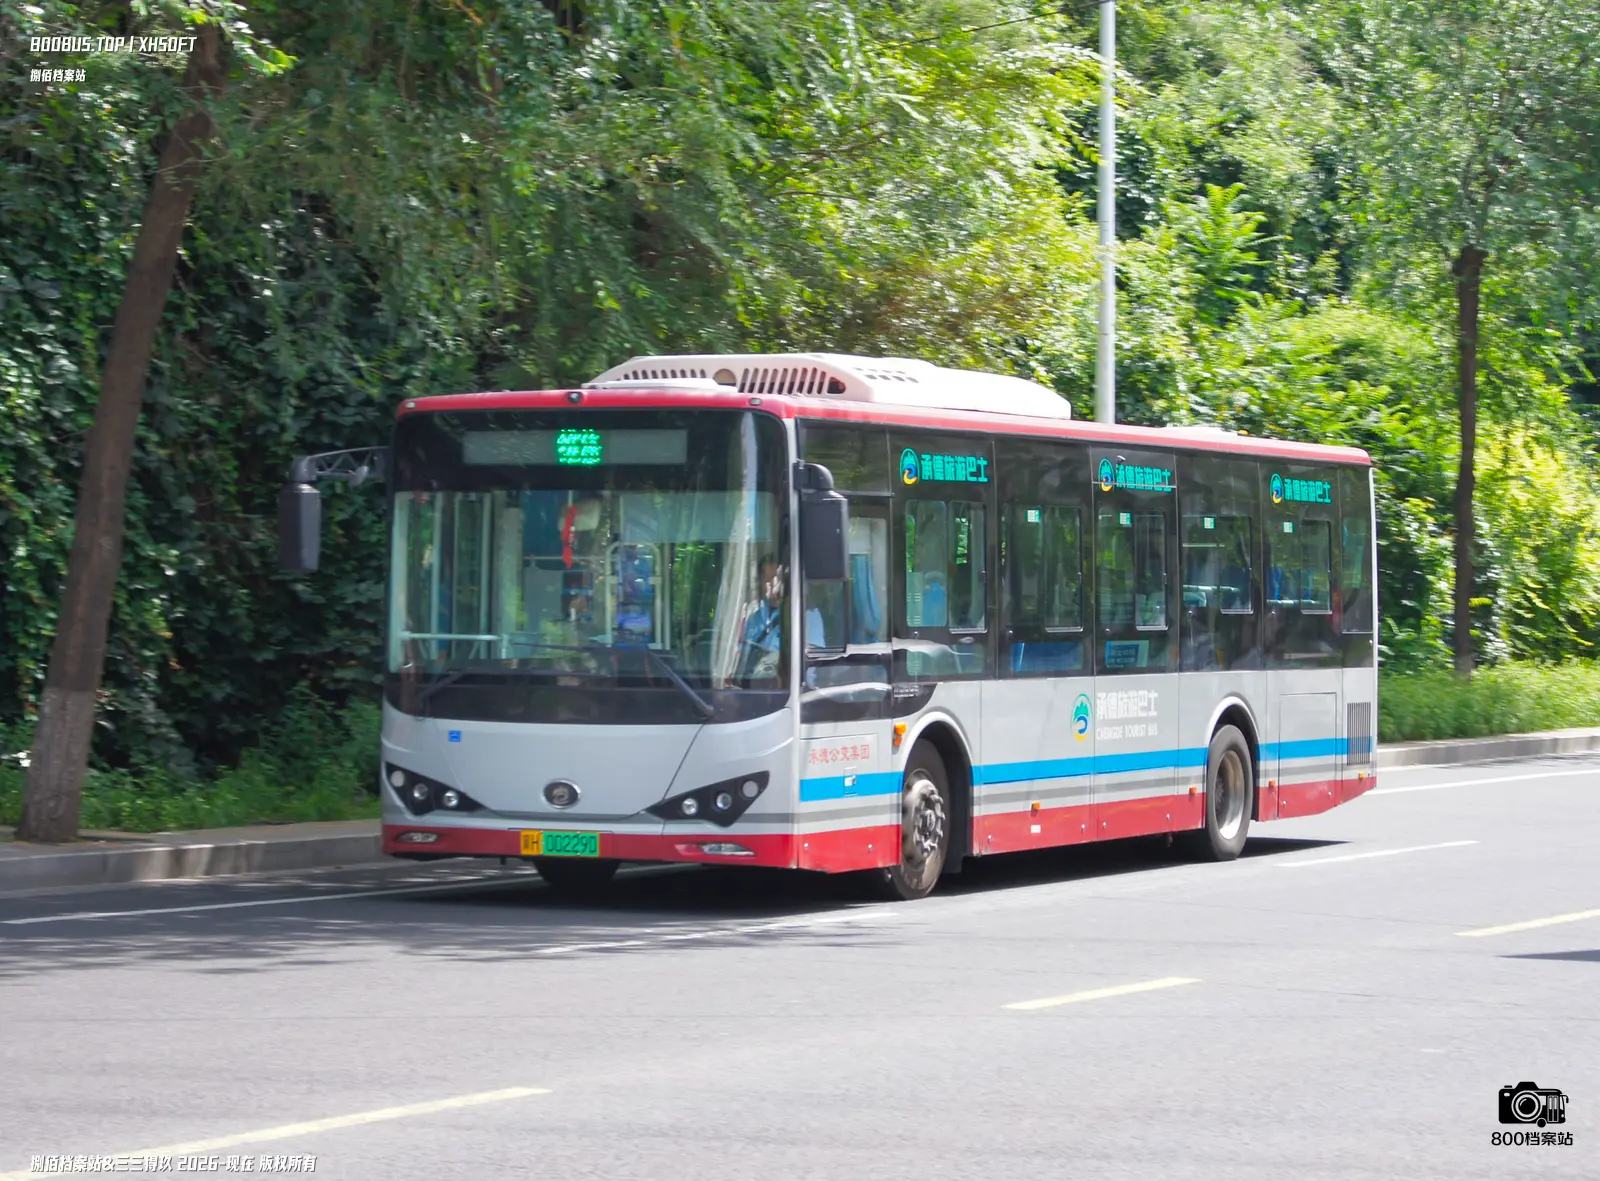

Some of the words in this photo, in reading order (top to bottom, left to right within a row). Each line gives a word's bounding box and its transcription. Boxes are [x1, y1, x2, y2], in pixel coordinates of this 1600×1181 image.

[921, 454, 989, 483] 承德旅游巴士
[1096, 689, 1159, 720] 承德旅游巴士
